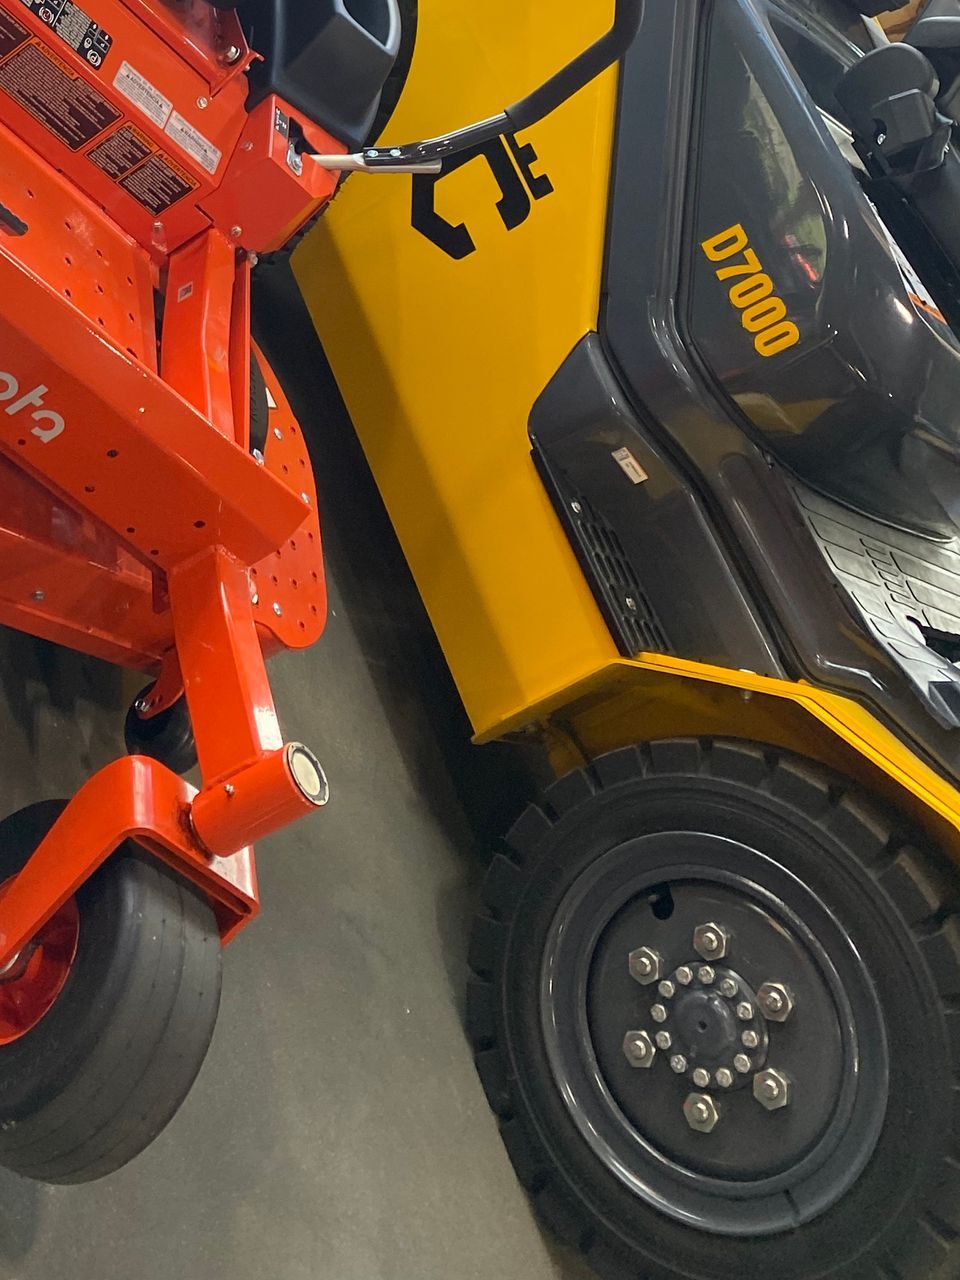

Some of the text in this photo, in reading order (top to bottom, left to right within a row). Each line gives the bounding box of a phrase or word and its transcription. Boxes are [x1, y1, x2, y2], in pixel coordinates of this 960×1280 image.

[40, 45, 75, 77] ADVERTENCIA
[130, 76, 160, 106] ADVERTENCIA
[164, 157, 197, 187] ADVERTENCIA
[701, 223, 800, 357] D7000
